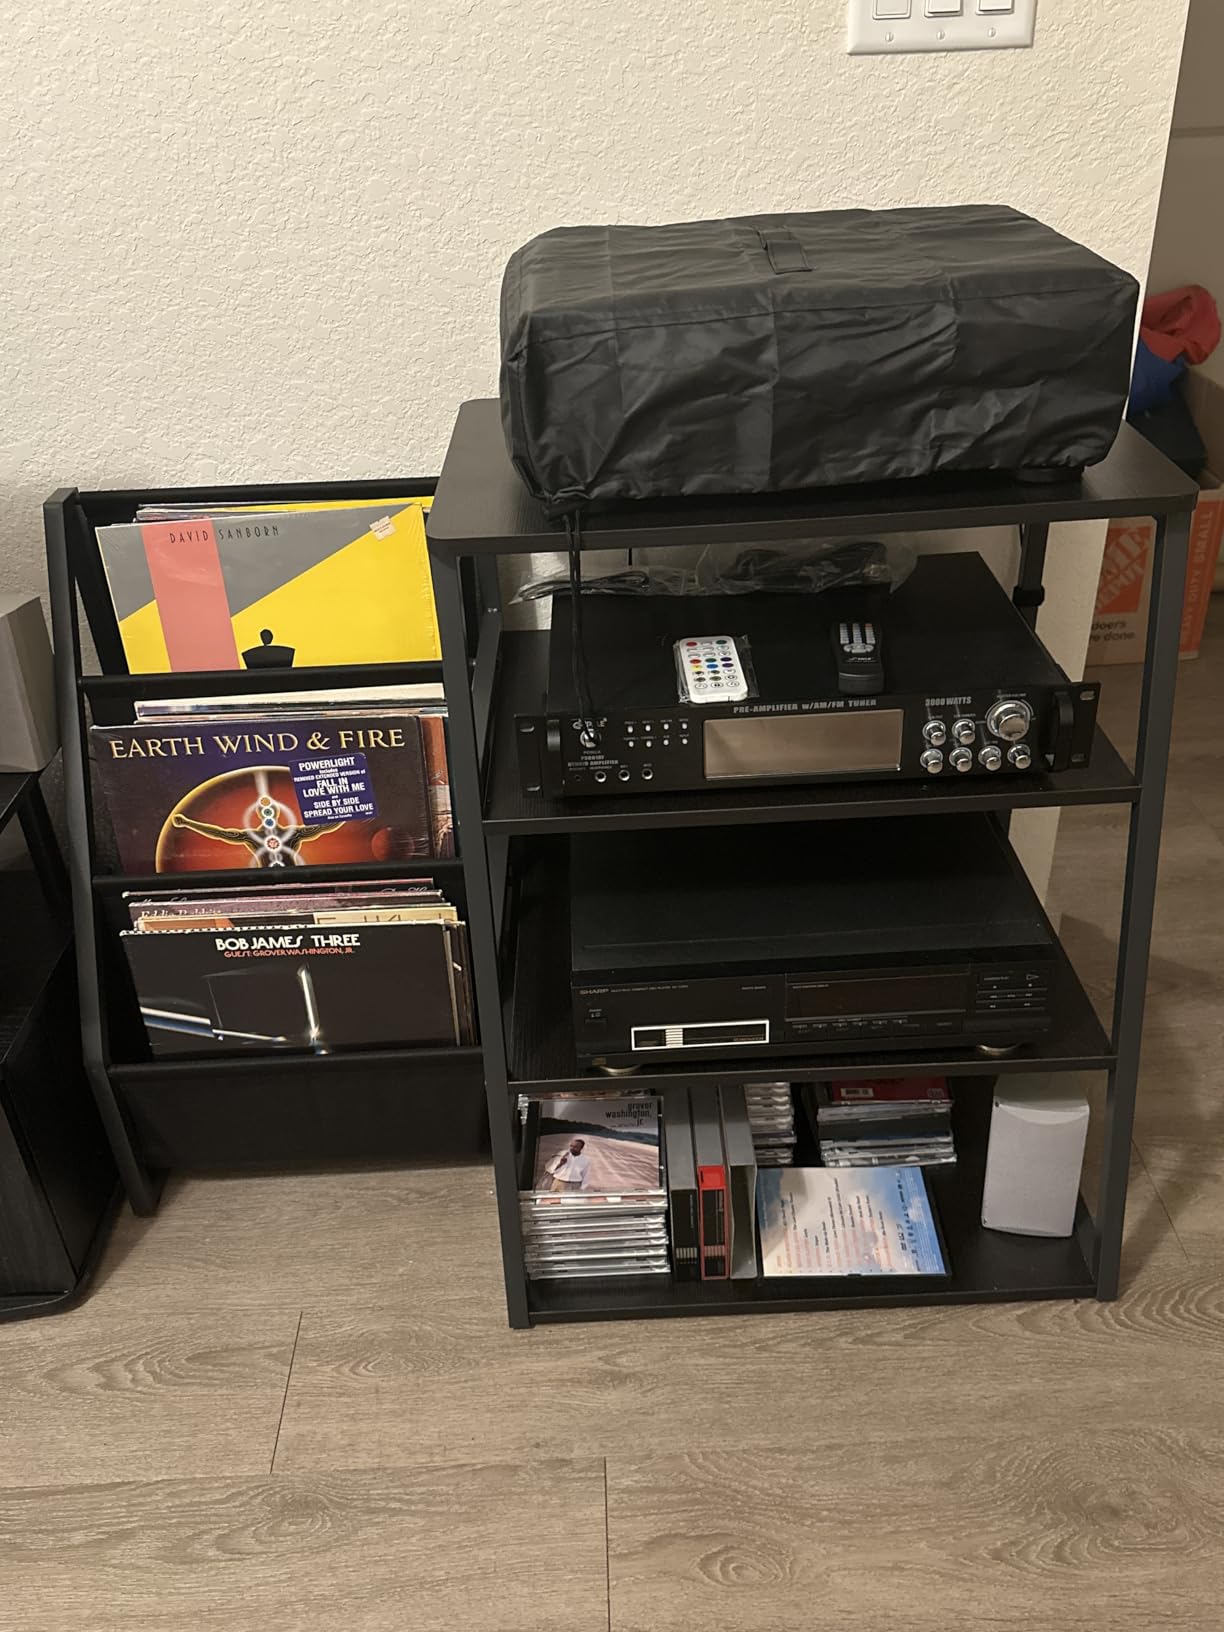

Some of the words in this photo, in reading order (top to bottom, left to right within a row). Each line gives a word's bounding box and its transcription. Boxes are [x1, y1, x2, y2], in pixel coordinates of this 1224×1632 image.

[169, 530, 210, 544] DAVID
[218, 525, 280, 541] SANBORN
[733, 704, 798, 714] PRE-AMPLIFIER
[802, 701, 844, 710] w/AM/FM
[848, 699, 876, 708] TUNER
[925, 698, 945, 706] 3000
[946, 696, 972, 705] WATTS
[109, 735, 205, 759] EARTH
[213, 732, 299, 754] WIND
[306, 732, 331, 750] &
[338, 728, 406, 750] FIRE
[298, 757, 355, 772] POWERLIGHT
[302, 788, 326, 798] LOVE
[326, 785, 350, 794] WITH
[352, 782, 365, 791] ME
[316, 779, 337, 788] FALL
[339, 777, 348, 785] IN
[303, 809, 333, 818] SPREAD
[333, 806, 354, 815] YOUR
[355, 803, 374, 812] LOVE
[313, 800, 331, 809] SIDE
[331, 798, 342, 807] BY
[343, 797, 360, 805] SIDE
[215, 938, 249, 951] BOB
[250, 935, 304, 950] JAMES
[311, 934, 361, 948] THREE
[253, 949, 287, 957] GROVER
[628, 1102, 653, 1111] grover
